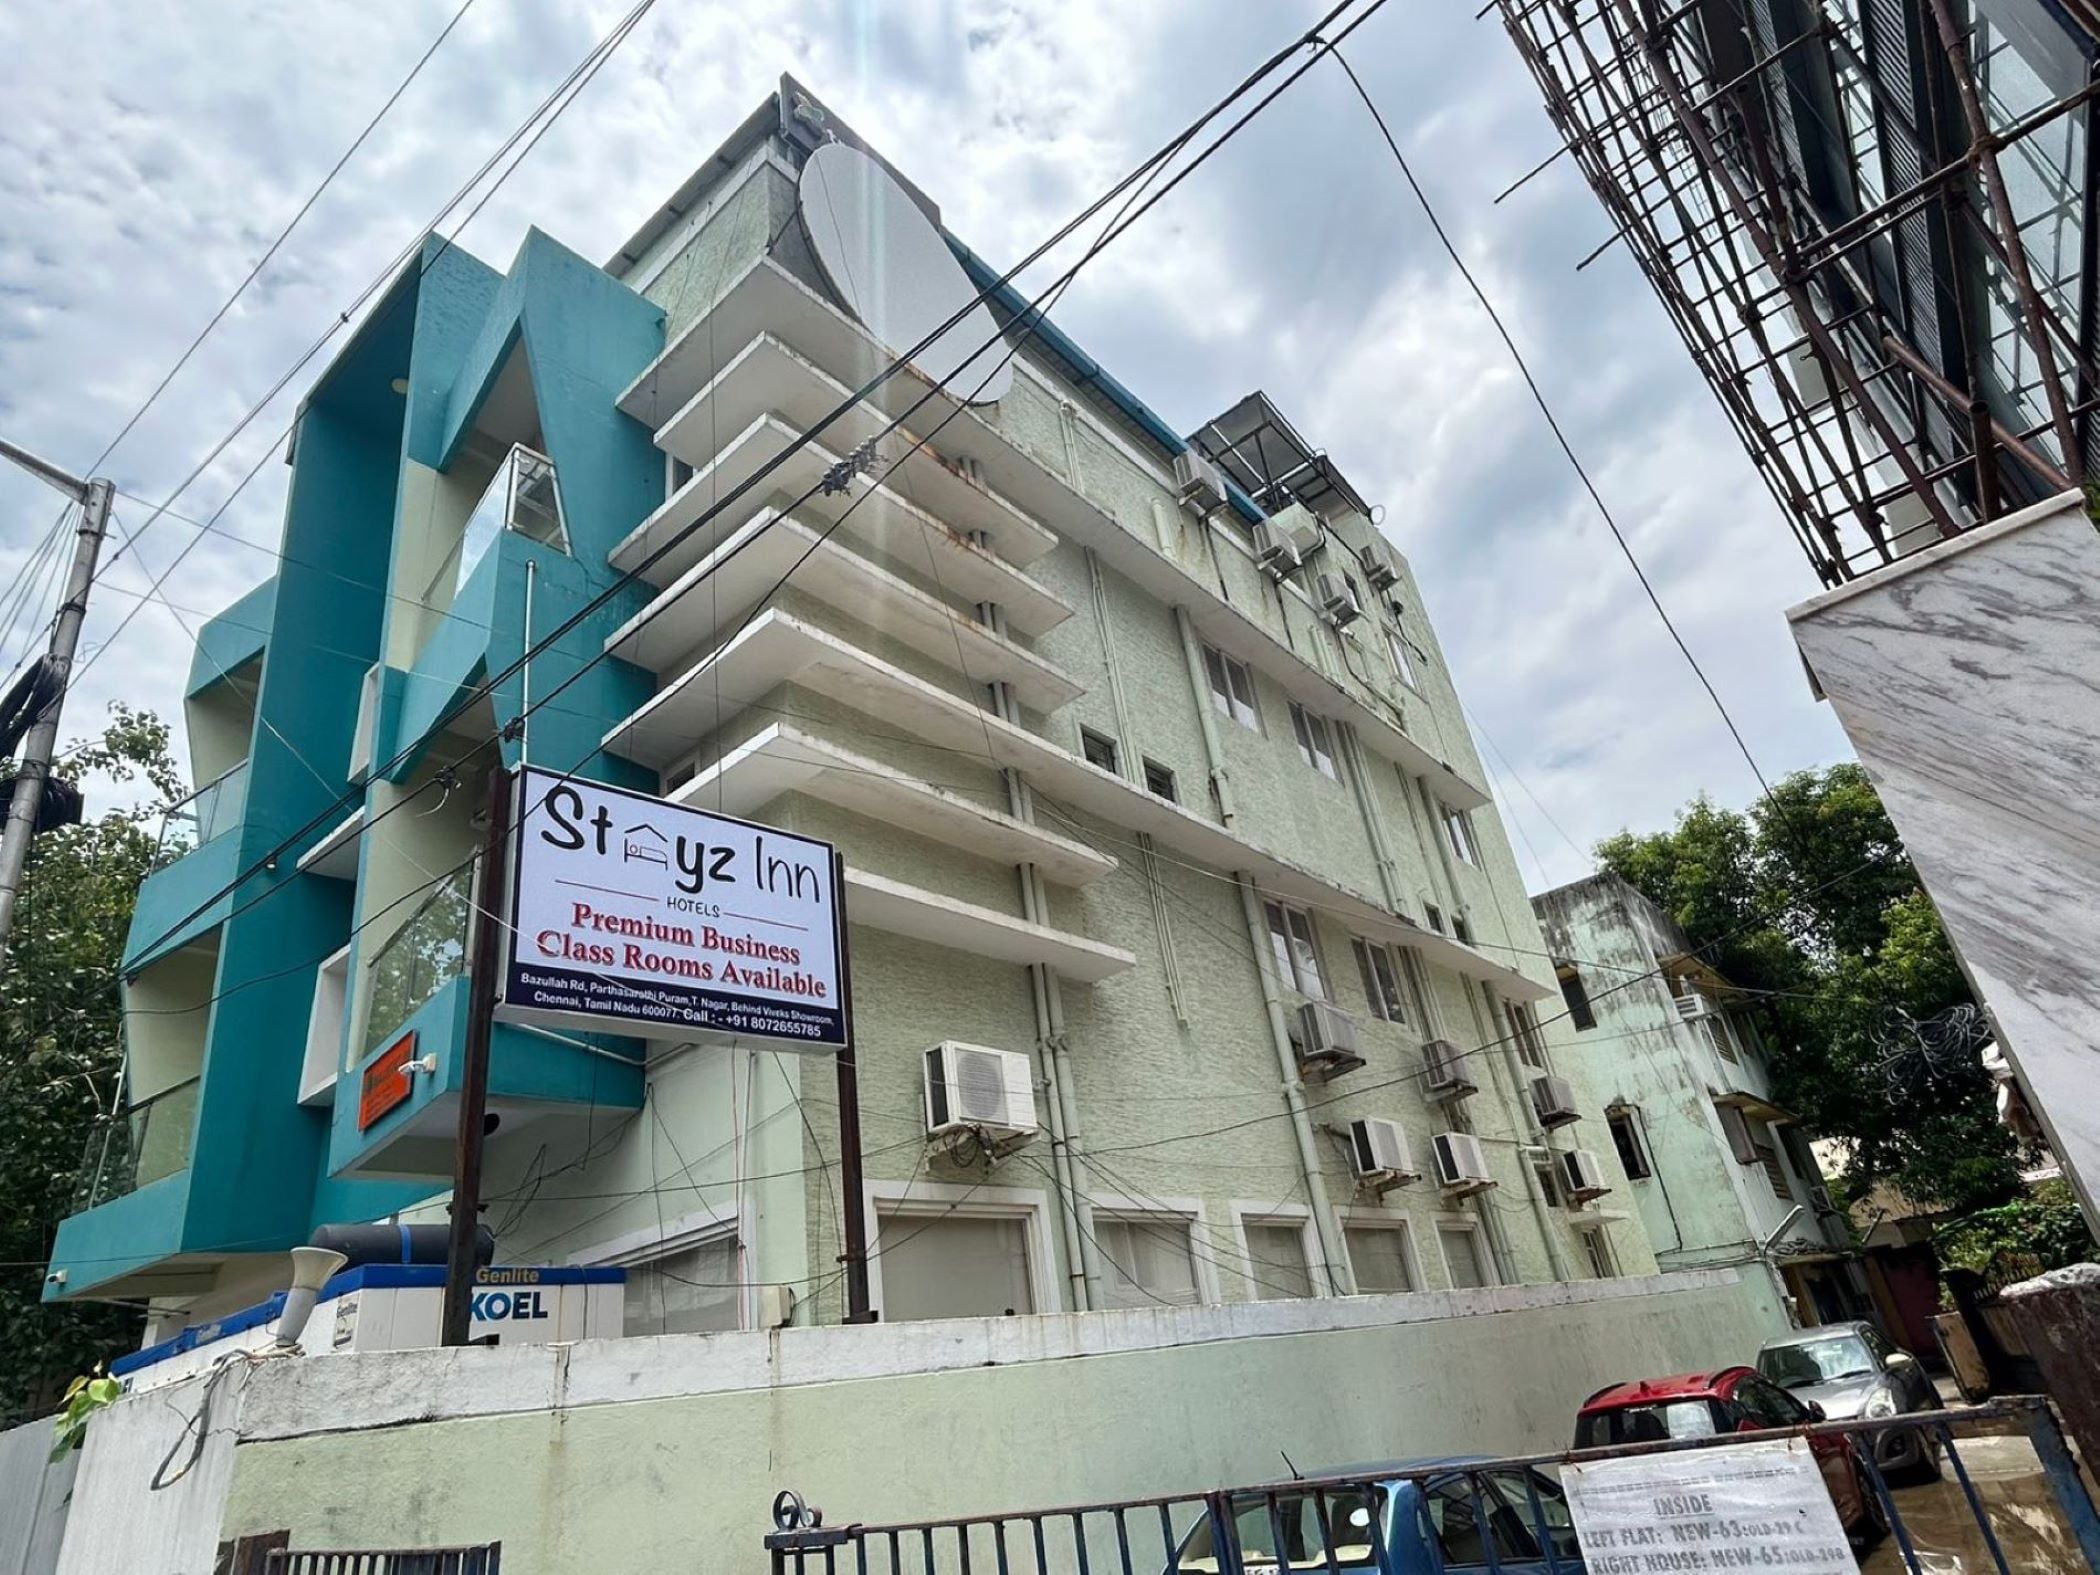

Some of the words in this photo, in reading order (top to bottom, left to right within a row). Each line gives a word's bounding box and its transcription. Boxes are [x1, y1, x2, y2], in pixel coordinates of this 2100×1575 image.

[756, 835, 820, 903] Inn
[667, 896, 720, 918] HOTELS
[571, 902, 702, 948] Premium
[700, 925, 801, 965] Business
[537, 930, 615, 966] Class
[622, 943, 713, 980] Rooms
[720, 960, 827, 998] Available
[520, 972, 568, 989] Bazullah
[569, 979, 588, 992] Rd,
[731, 1002, 761, 1015] Behind
[534, 990, 582, 1008] Chennai,
[584, 997, 611, 1011] Tamil
[613, 1001, 640, 1014] Nadu
[683, 1008, 708, 1022] Call
[726, 1014, 747, 1028] +91
[751, 1016, 821, 1037] 8072655785
[476, 1268, 540, 1283] Genlite
[1653, 1494, 1713, 1515] INSIDE
[1583, 1530, 1616, 1547] LEFT
[1619, 1526, 1663, 1546] FLAT:
[1590, 1555, 1640, 1575] RIGHT
